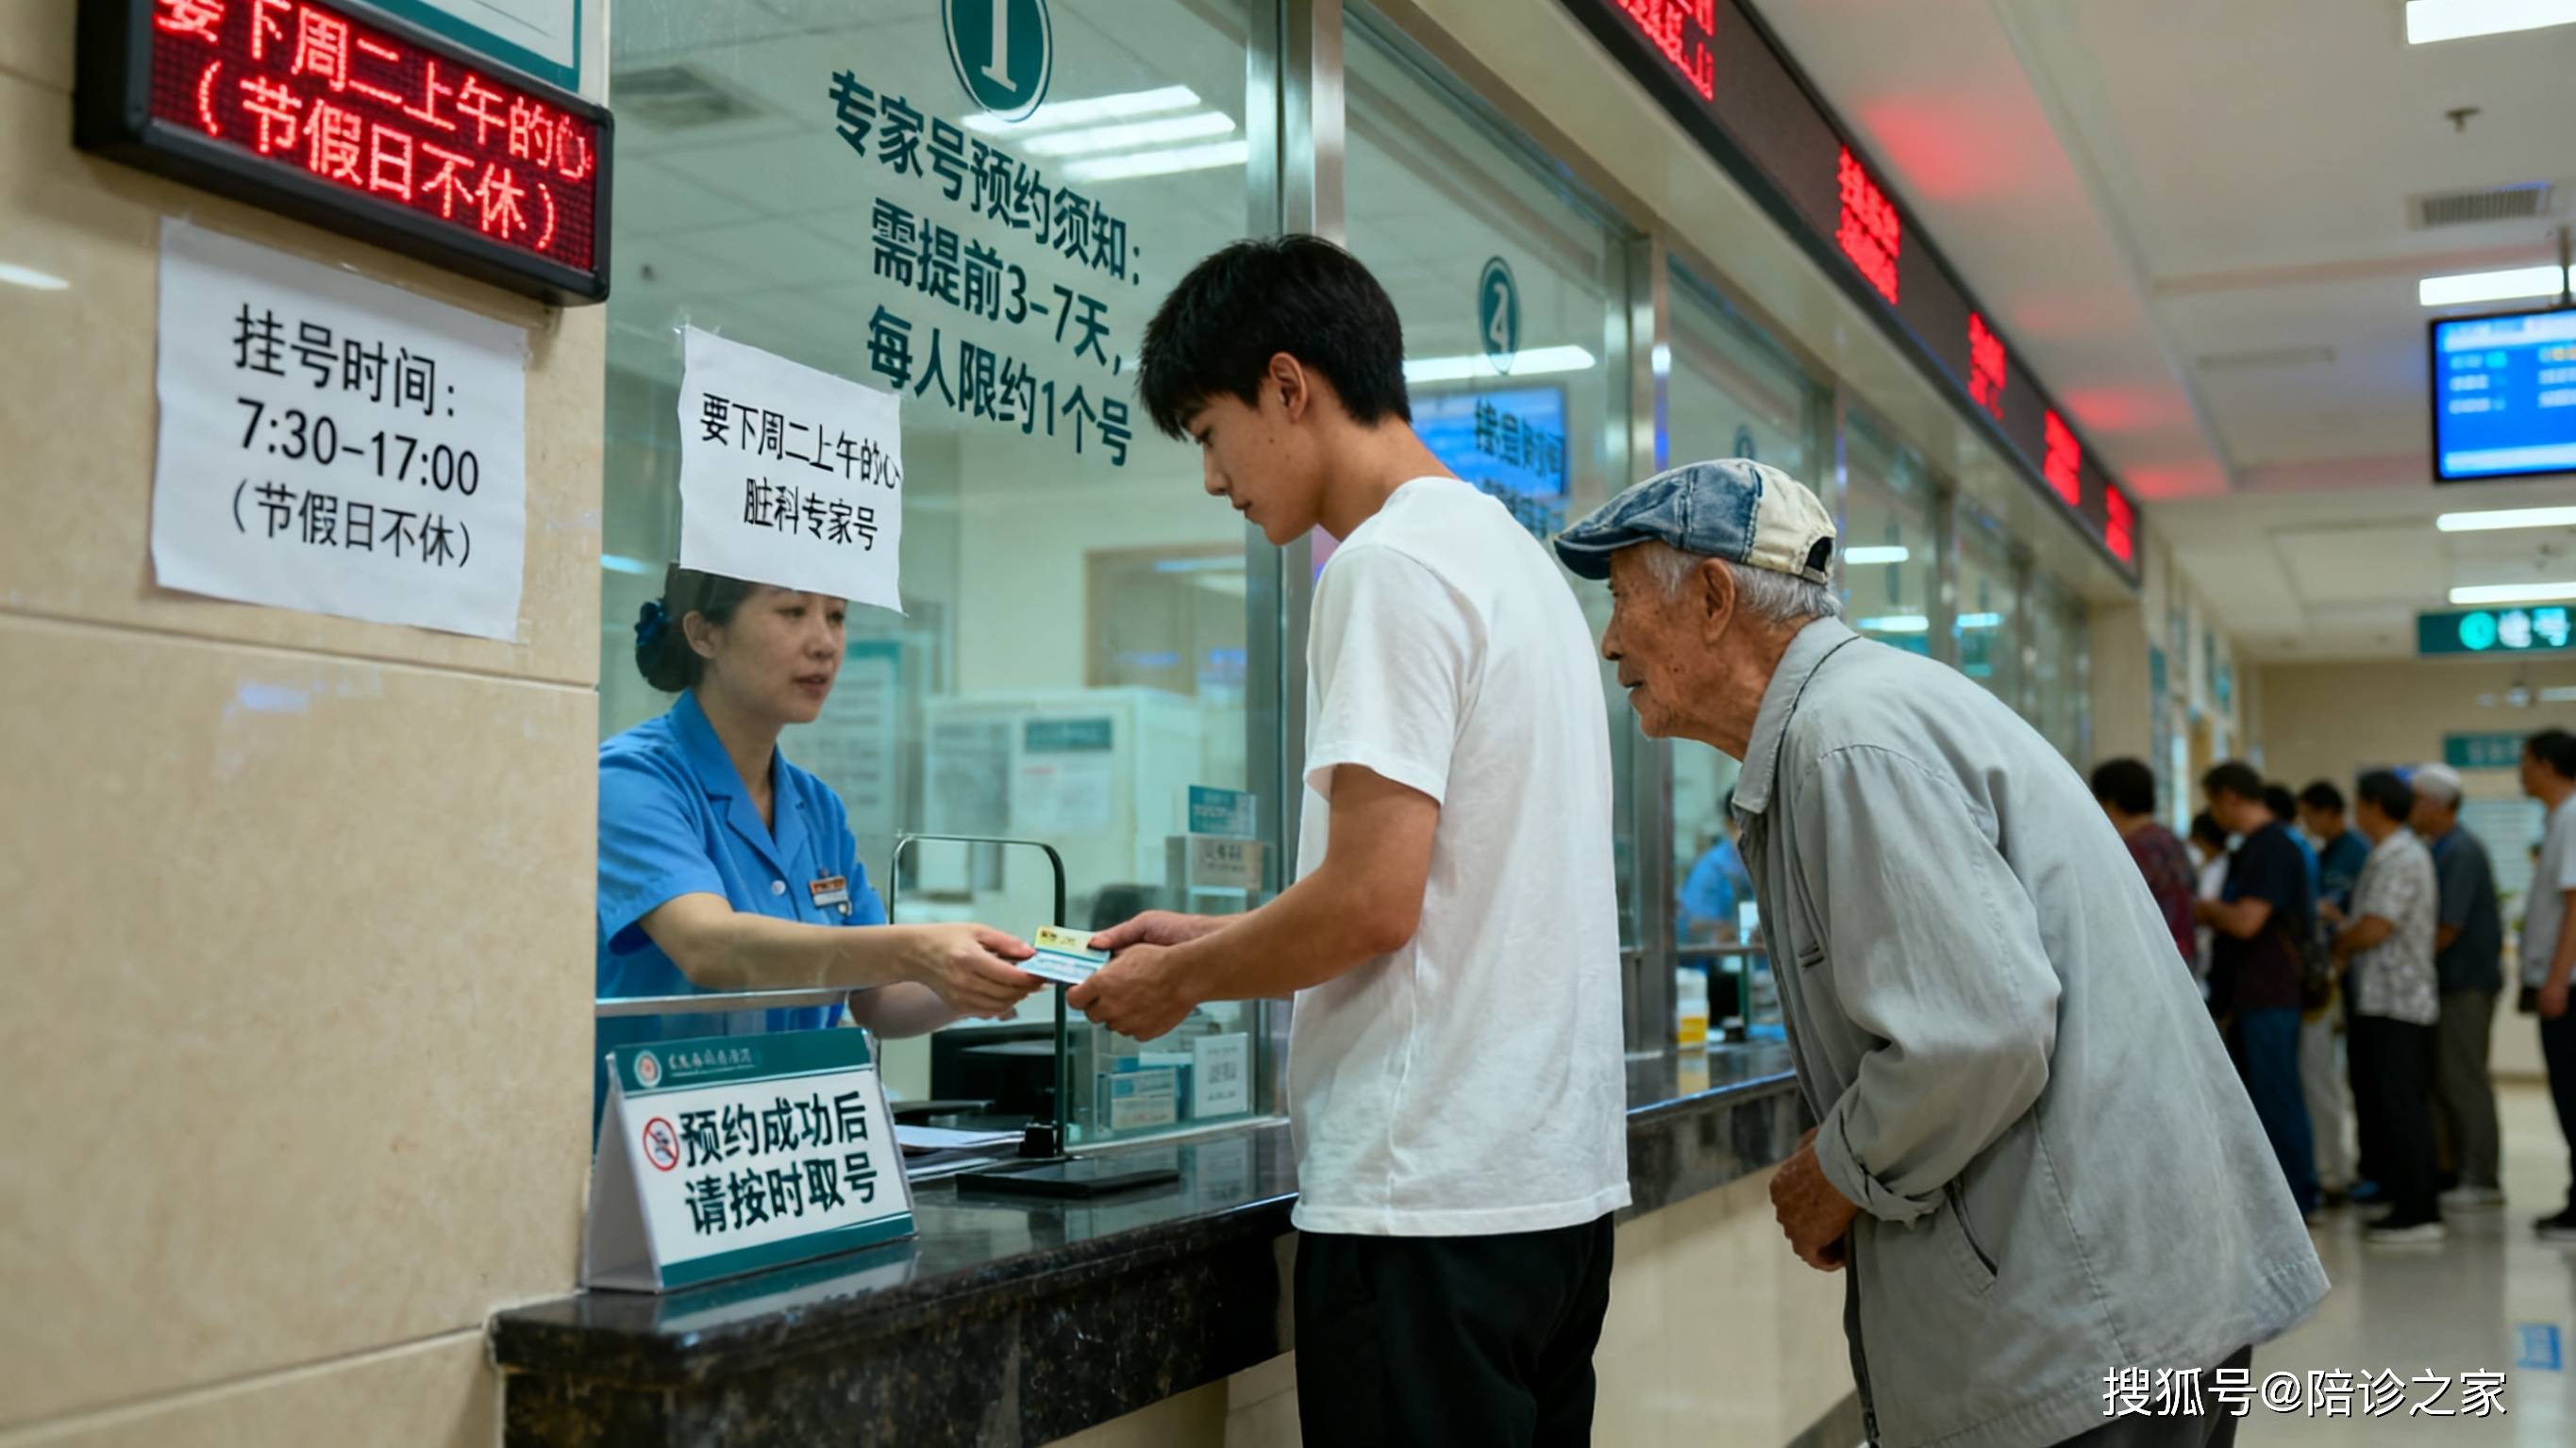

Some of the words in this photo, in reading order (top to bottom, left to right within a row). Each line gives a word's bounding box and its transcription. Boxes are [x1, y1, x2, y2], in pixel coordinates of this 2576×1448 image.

[197, 61, 556, 251] （节假日不休）
[828, 69, 1141, 286] 专家号预约须知：
[233, 303, 455, 417] 挂号时间：
[867, 304, 1131, 467] 每人限约1个号
[237, 397, 479, 496] 7:30-17:00
[233, 479, 471, 569] （节假日不休）
[744, 476, 878, 551] 脏科专家号
[678, 1090, 868, 1168] 预约成功后
[685, 1152, 878, 1235] 请按时取号
